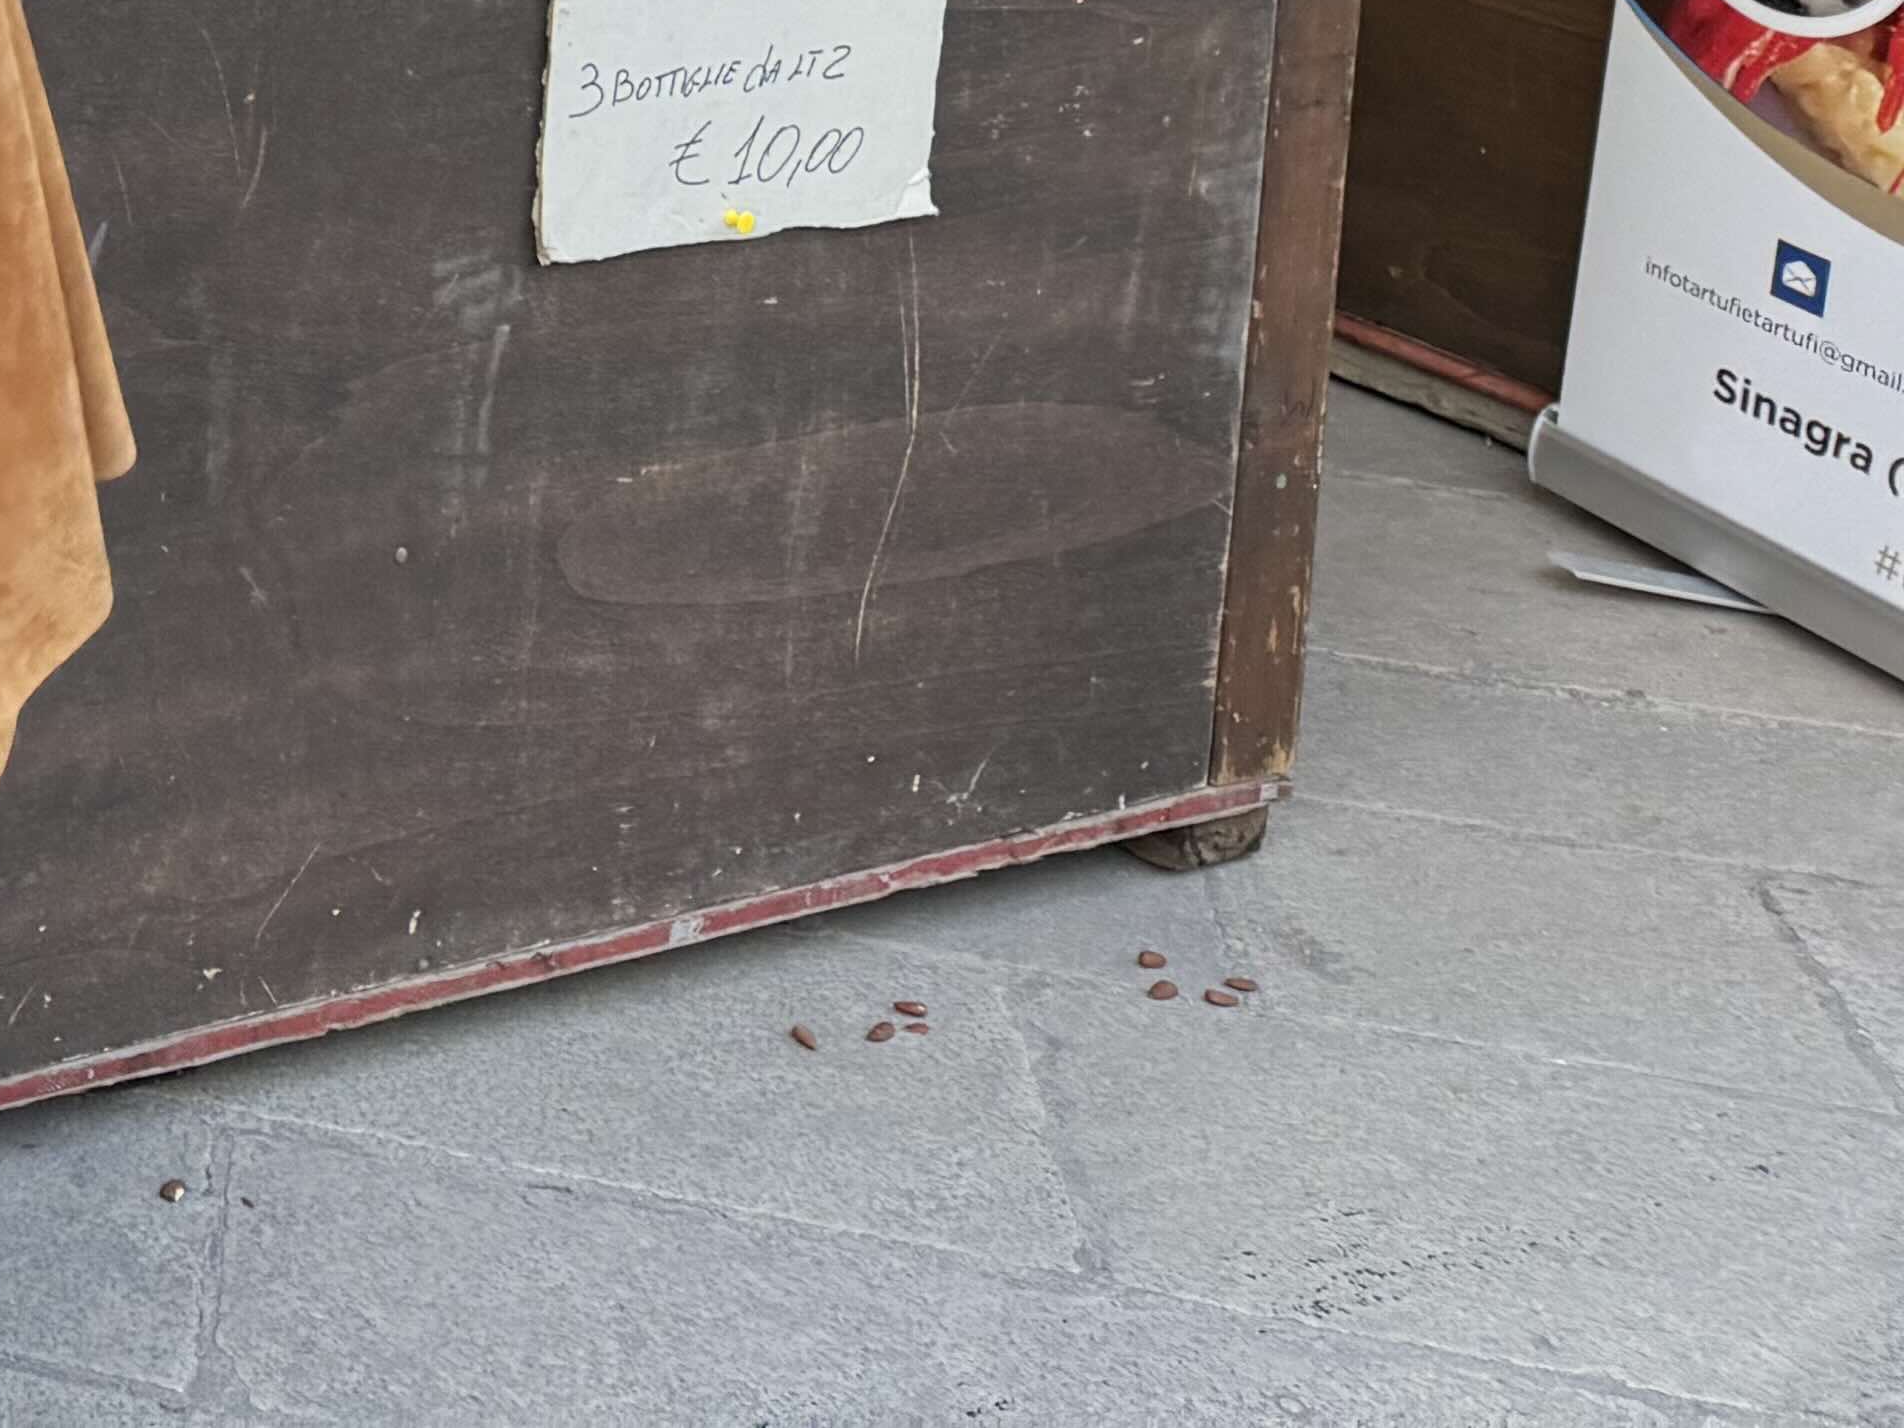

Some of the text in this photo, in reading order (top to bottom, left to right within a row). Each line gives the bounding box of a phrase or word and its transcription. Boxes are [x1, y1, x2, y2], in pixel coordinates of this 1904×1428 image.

[668, 114, 865, 188] € 10,00
[1712, 366, 1875, 476] Sinagra
